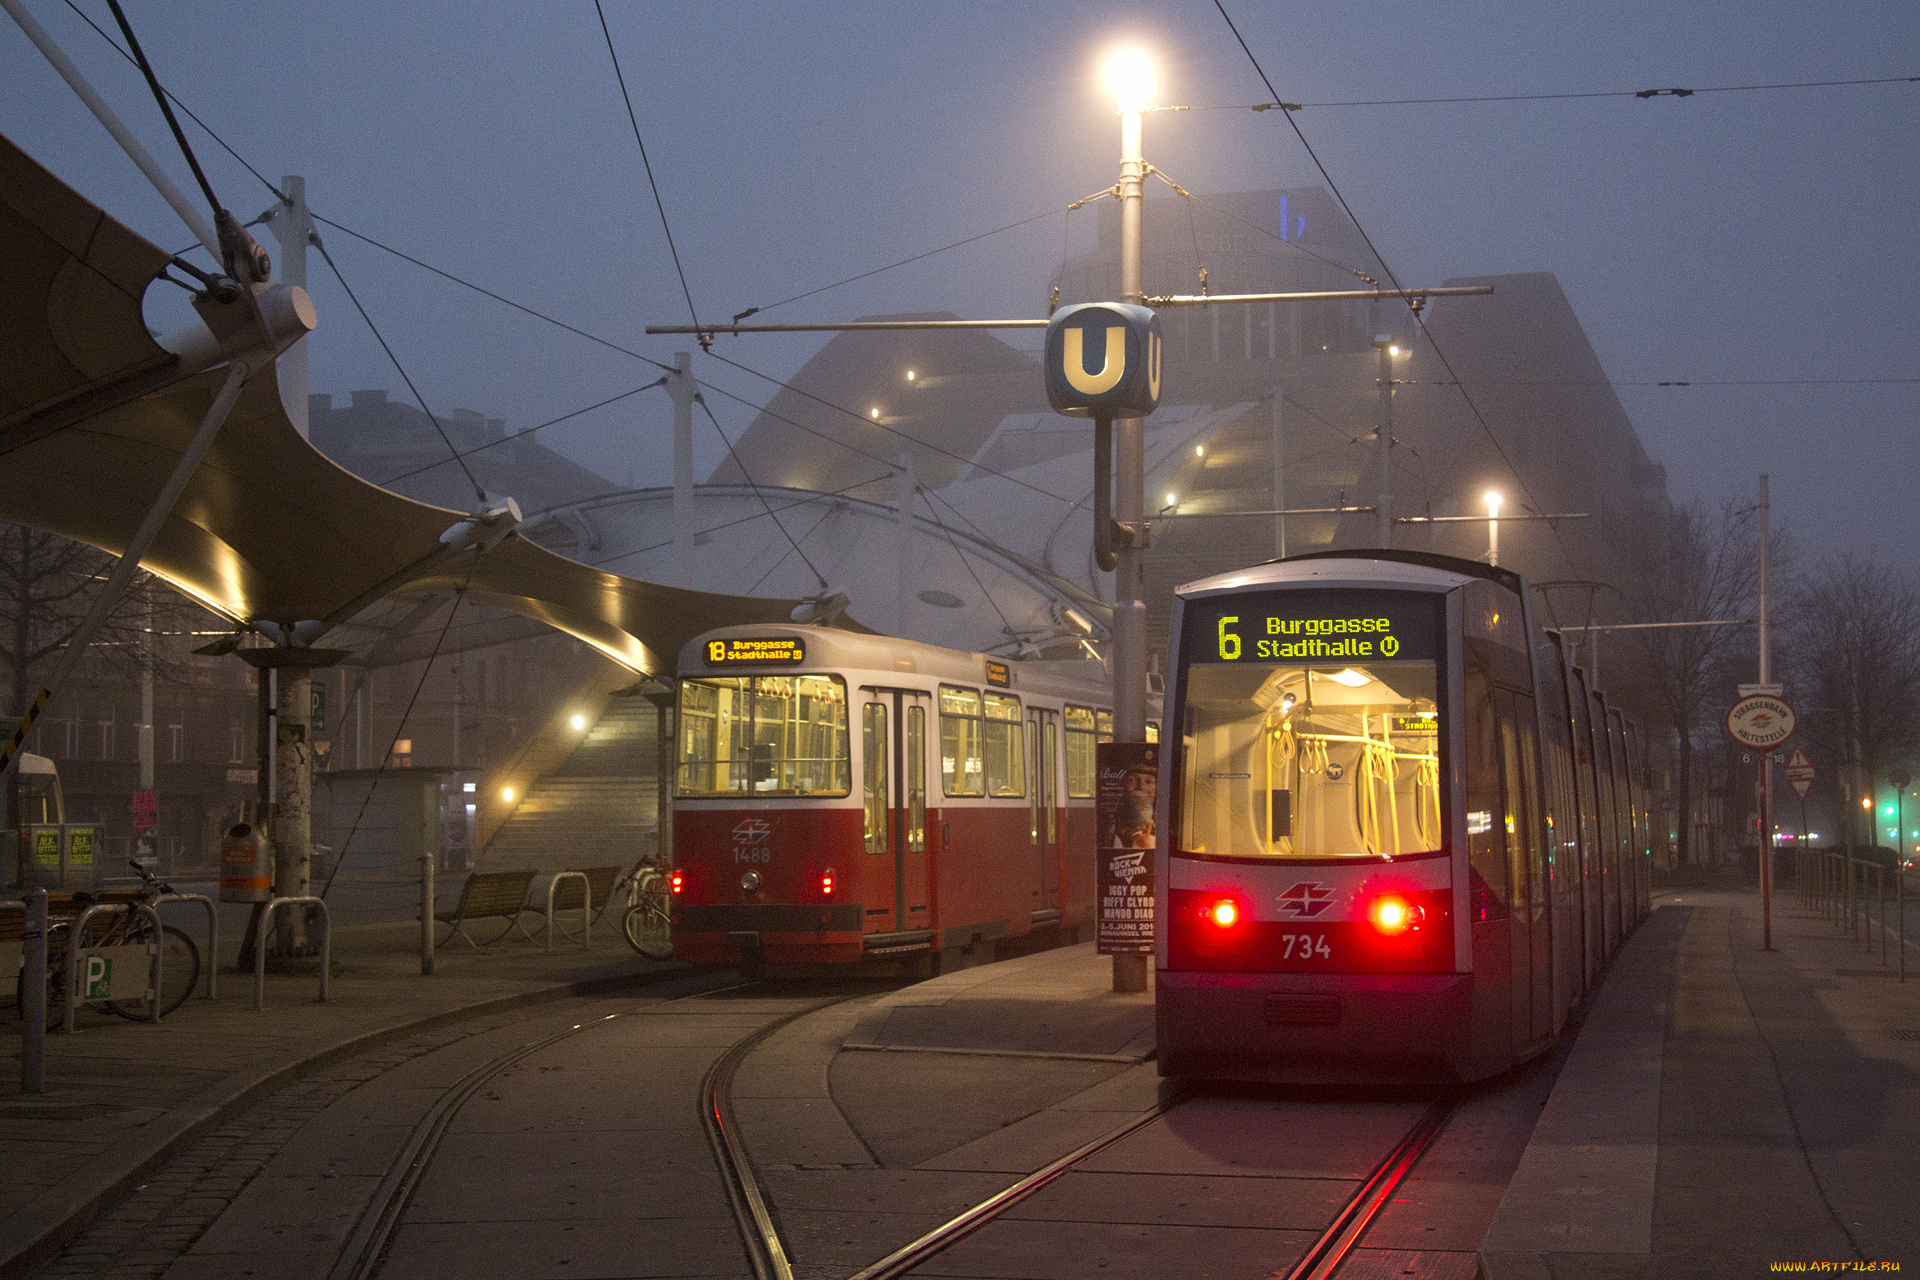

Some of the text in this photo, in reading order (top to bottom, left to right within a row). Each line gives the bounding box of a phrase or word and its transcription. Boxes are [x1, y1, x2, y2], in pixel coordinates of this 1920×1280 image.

[1063, 327, 1126, 395] U
[1148, 331, 1161, 402] U
[1266, 617, 1390, 635] Burggasse
[733, 641, 795, 650] Burggasse
[1218, 616, 1242, 660] 6
[708, 641, 725, 661] 18
[727, 650, 791, 660] Stadthalle
[1257, 638, 1373, 657] Stadthalle
[312, 693, 320, 716] P
[1733, 701, 1789, 720] STRASSENBAHN
[1737, 726, 1788, 743] HALTESTELLE
[1742, 753, 1751, 764] 6
[733, 847, 771, 863] 1488
[1110, 860, 1131, 871] ROCK
[1109, 885, 1147, 896] IGGY POP
[1127, 897, 1154, 908] CLYRO
[1134, 908, 1154, 919] DIAO
[1282, 934, 1331, 959] 734
[86, 956, 105, 996] P
